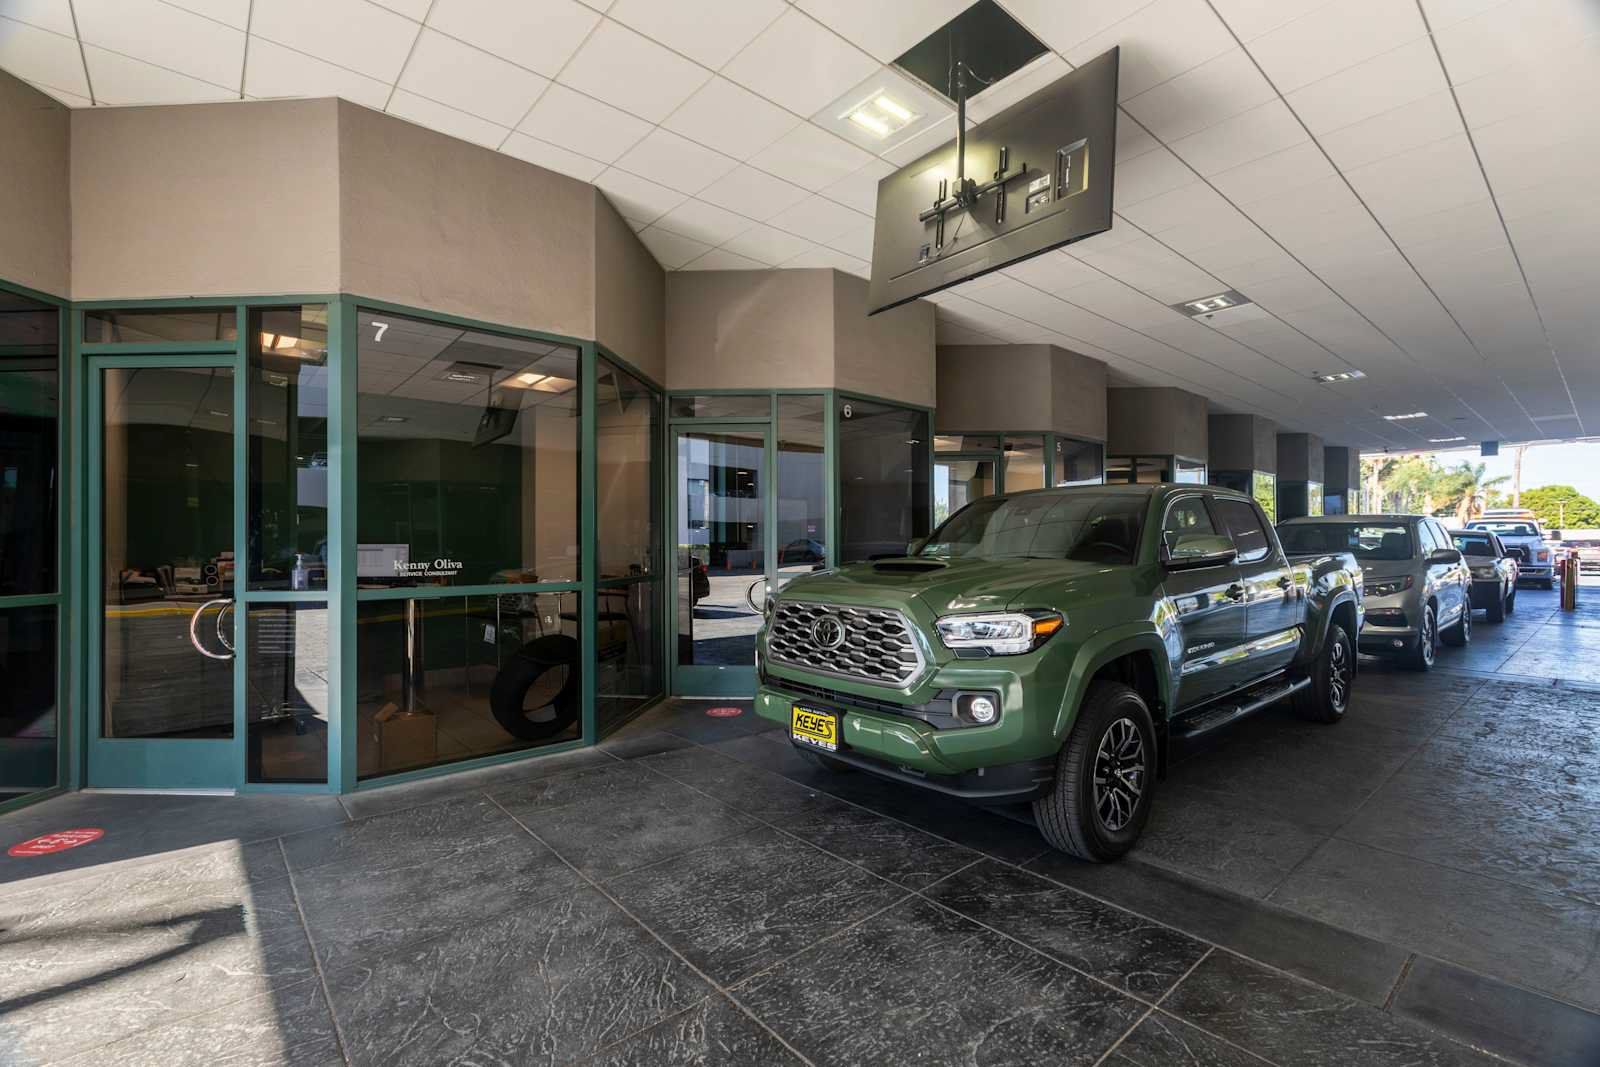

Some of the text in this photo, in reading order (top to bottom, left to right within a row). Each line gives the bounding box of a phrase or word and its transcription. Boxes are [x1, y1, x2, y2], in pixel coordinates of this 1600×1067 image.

[371, 321, 388, 342] 7
[843, 404, 852, 418] 6
[1056, 441, 1061, 452] 5
[393, 559, 463, 574] Kenny Oliva
[795, 713, 835, 739] KEYES
[793, 733, 837, 751] KEYES
